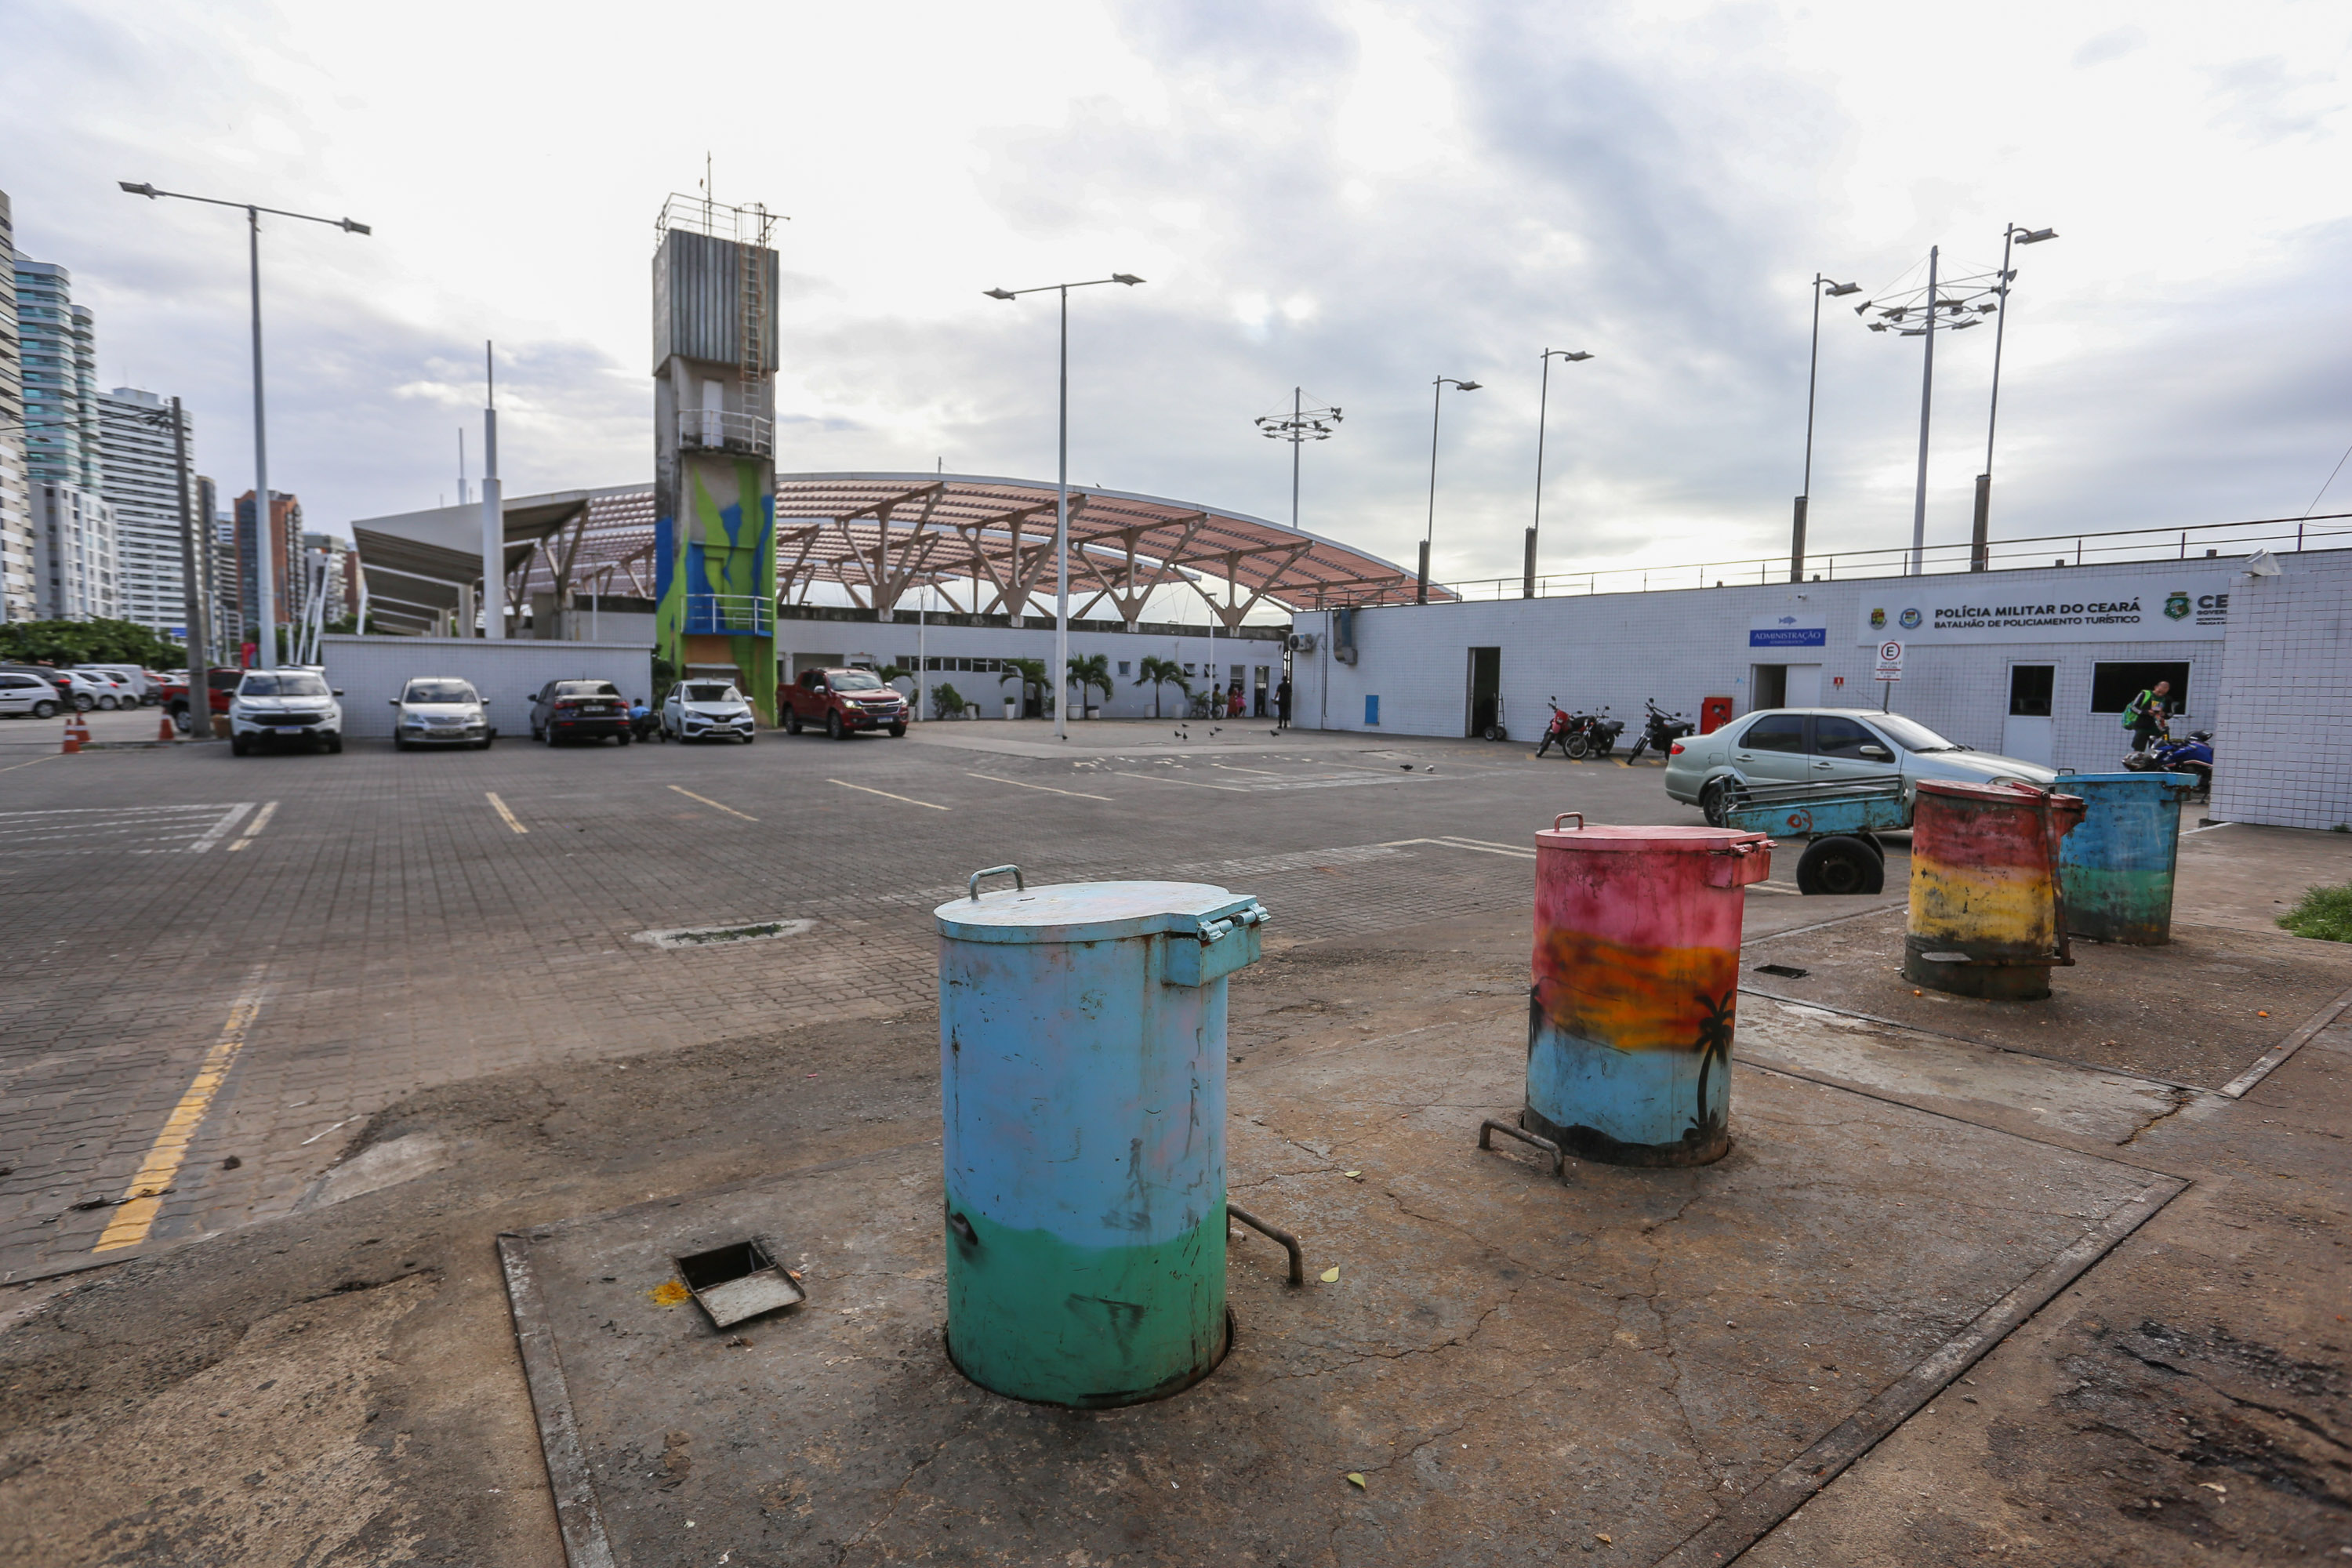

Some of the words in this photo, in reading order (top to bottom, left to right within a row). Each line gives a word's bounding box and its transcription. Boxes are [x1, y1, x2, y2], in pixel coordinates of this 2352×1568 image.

[1935, 604, 1991, 619] POLÍCIA
[1994, 604, 2056, 616] MILITAR
[2060, 603, 2084, 614] DO
[2087, 597, 2140, 613] CEARÁ
[1934, 619, 1985, 629] BATALHÃO
[2003, 617, 2082, 627] POLICIAMENTO
[2085, 613, 2140, 624] TURÍSTICO
[1755, 630, 1821, 640] ADMINISTRAÇÃO
[1886, 646, 1895, 656] E
[1787, 808, 1813, 832] 03
